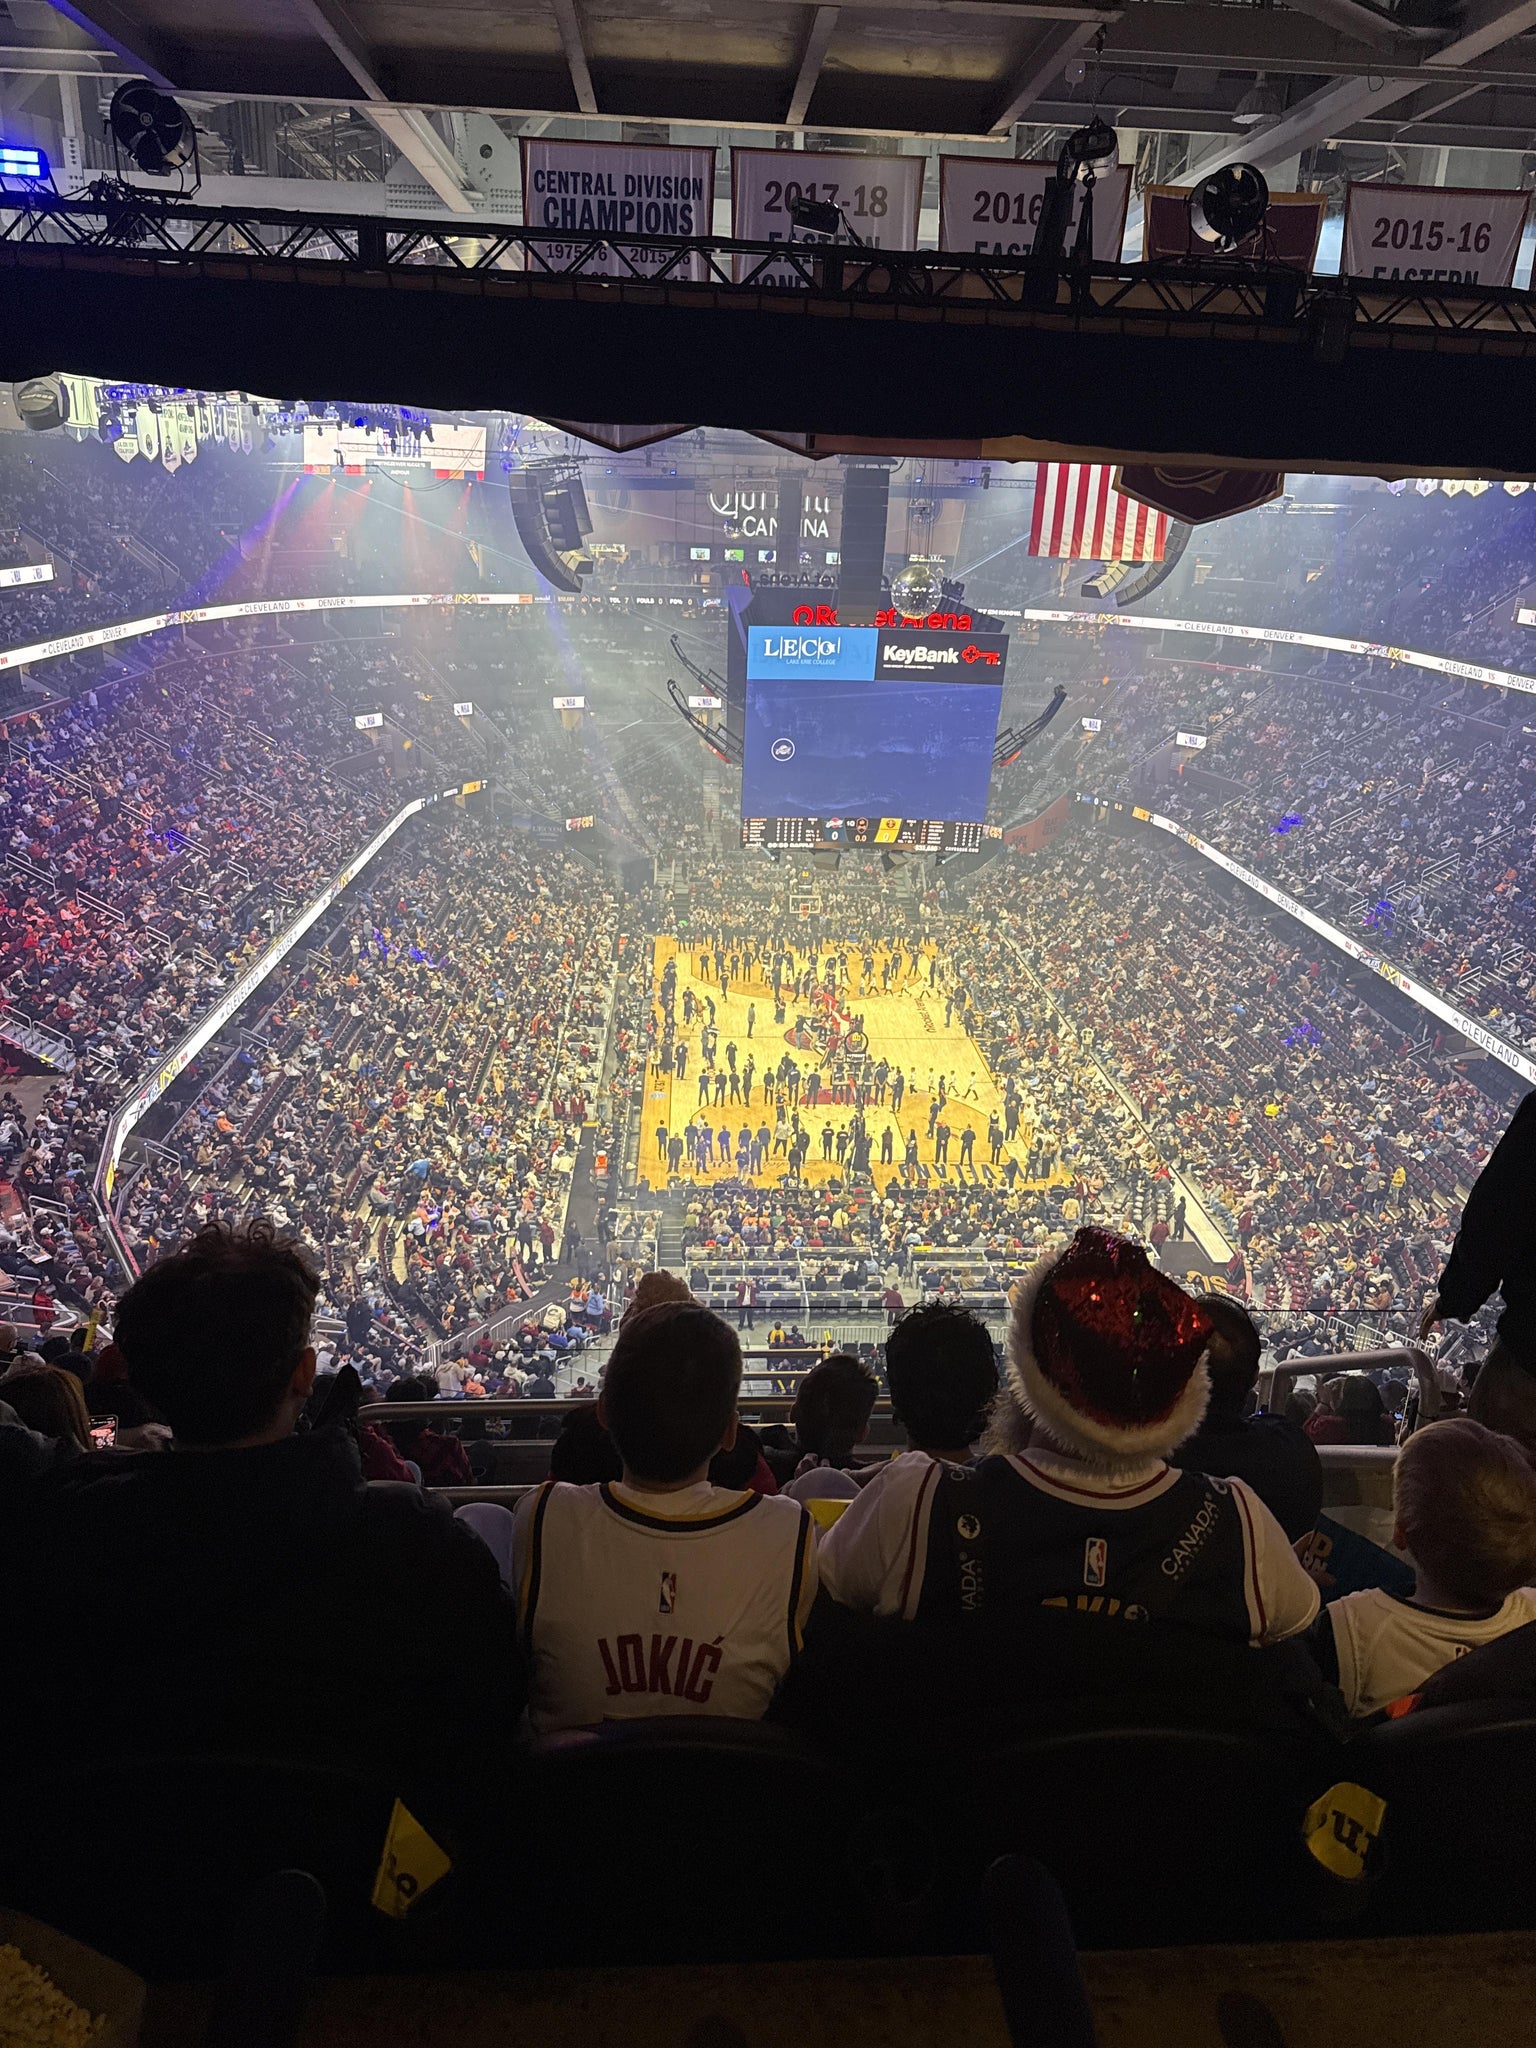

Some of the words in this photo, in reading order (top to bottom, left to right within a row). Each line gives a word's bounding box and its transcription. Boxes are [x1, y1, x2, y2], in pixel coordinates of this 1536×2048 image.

[534, 169, 617, 197] CENTRAL
[624, 174, 703, 201] DIVISION
[764, 180, 888, 218] 2017-18
[543, 196, 694, 236] CHAMPIONS
[1371, 217, 1492, 254] 2015-16
[244, 601, 290, 614] CLEVELAND
[318, 598, 346, 608] DENVER
[816, 605, 897, 627] Roet
[48, 636, 84, 655] CLEVELAND
[102, 627, 122, 641] DENVER
[1184, 622, 1234, 635] CLEVELAND
[1263, 629, 1295, 641] DENVER
[883, 645, 959, 665] KeyBank
[1444, 661, 1483, 678] CLEVELAND
[1507, 675, 1535, 691] DENVER
[831, 831, 839, 841] 0
[1229, 862, 1260, 889] CLEVELAND
[1277, 893, 1298, 915] DENVER
[225, 972, 260, 1015] CLEVELAND
[1461, 1019, 1520, 1068] CLEVELAND
[597, 1633, 725, 1704] JOKIĆ
